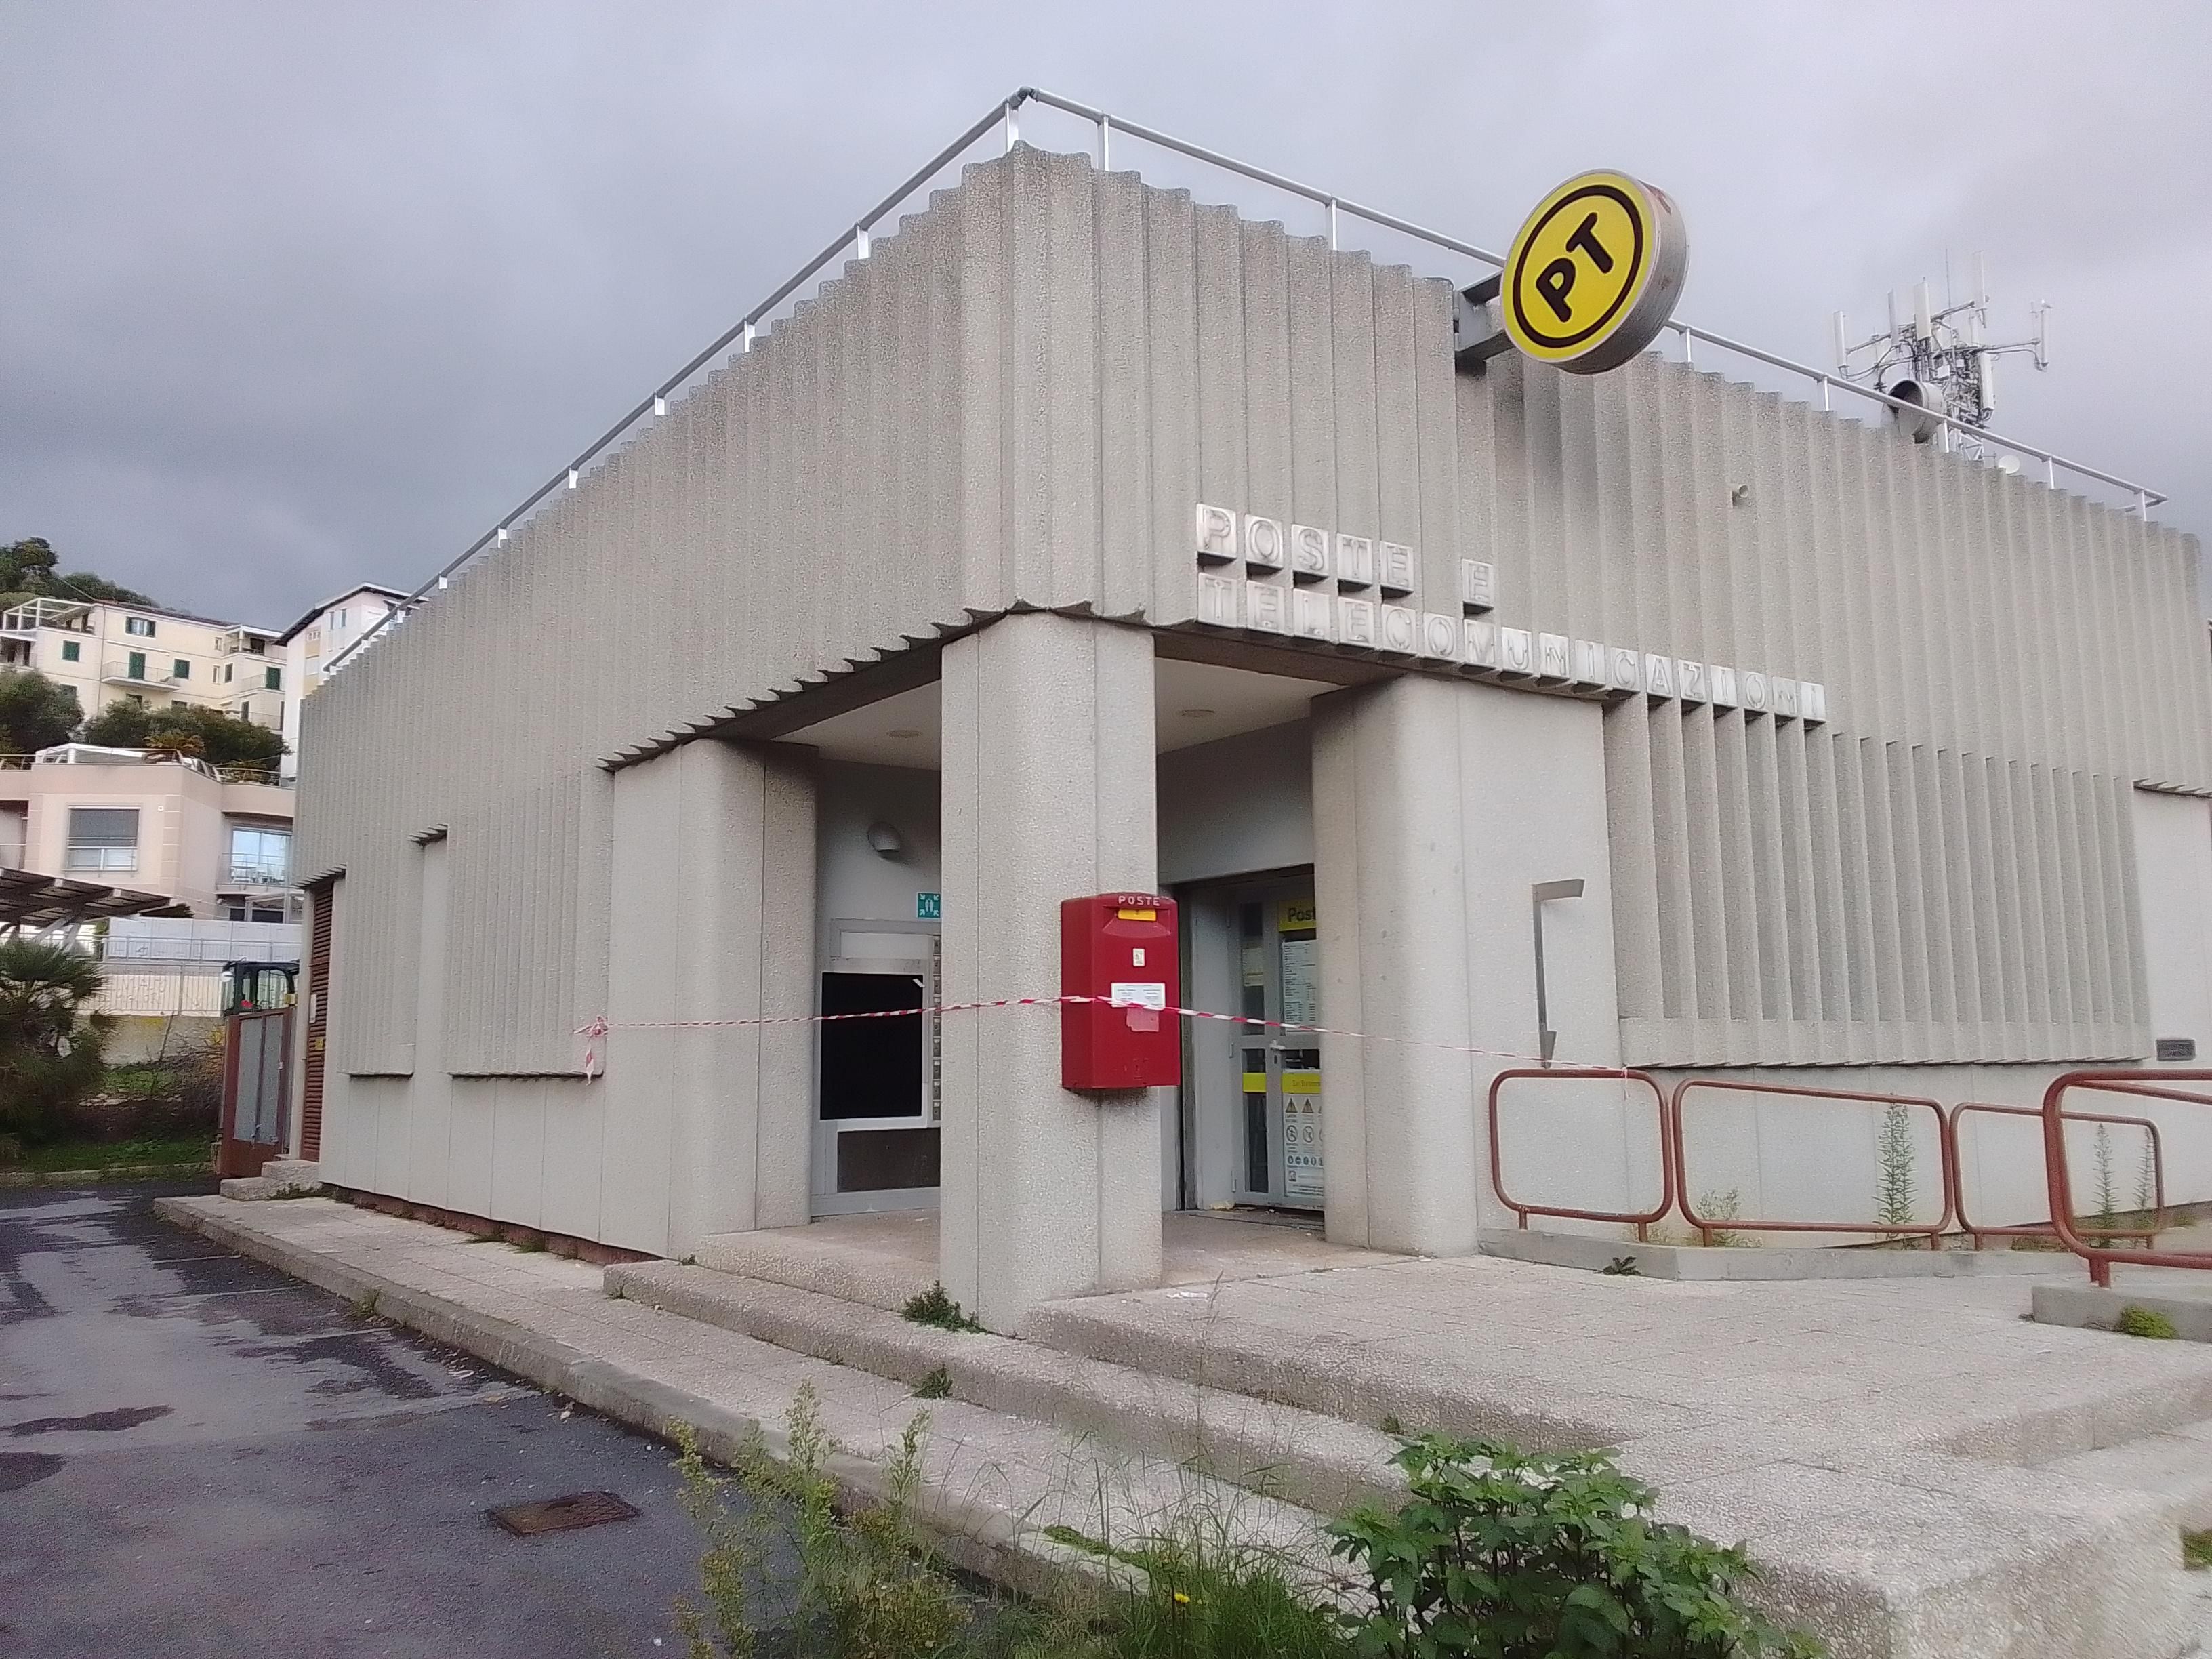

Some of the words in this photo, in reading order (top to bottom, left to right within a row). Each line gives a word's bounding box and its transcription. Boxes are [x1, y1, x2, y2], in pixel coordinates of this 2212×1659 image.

[1535, 211, 1614, 323] PT
[1198, 506, 1414, 588] POSTE
[1463, 560, 1494, 603] E
[1200, 575, 1824, 720] TELECOMUNICAZIONI
[1118, 895, 1161, 907] POSTE
